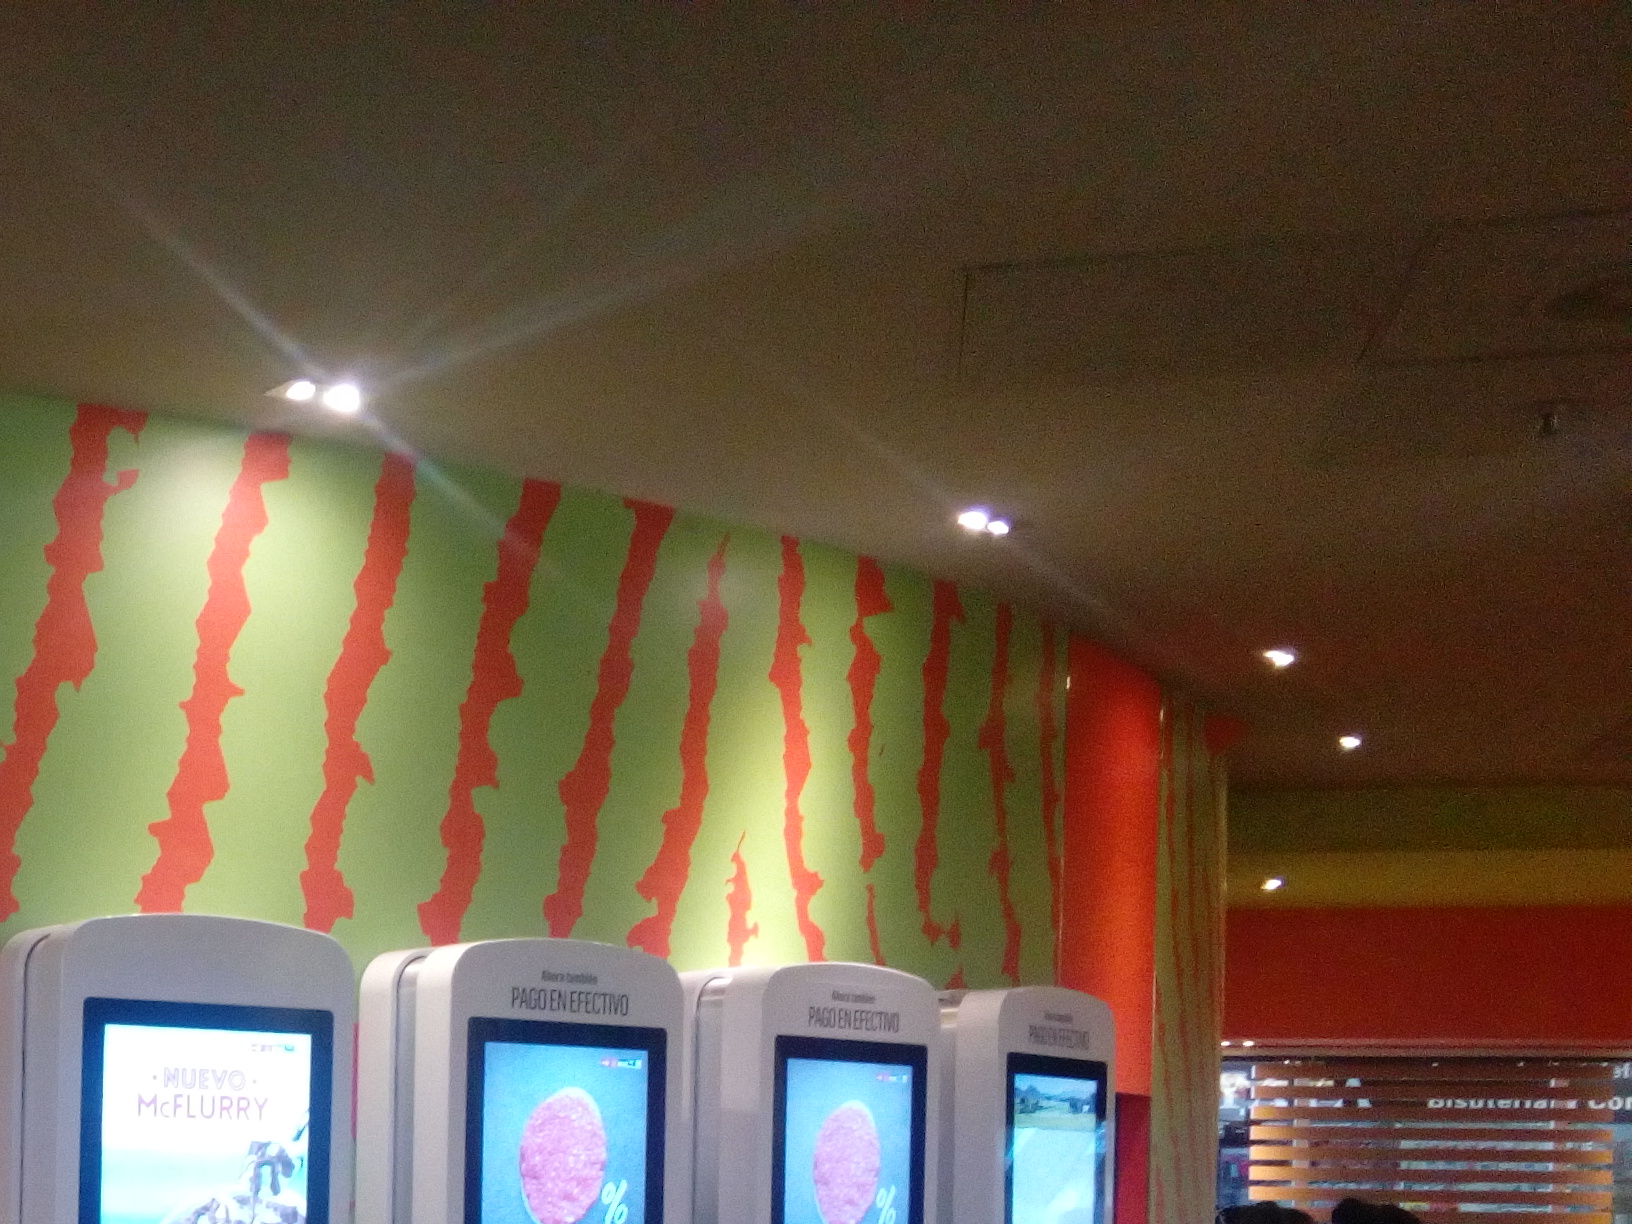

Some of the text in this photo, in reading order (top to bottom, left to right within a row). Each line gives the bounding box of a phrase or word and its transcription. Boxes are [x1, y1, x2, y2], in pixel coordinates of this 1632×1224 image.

[511, 987, 630, 1016] PAGO EN EFECTIVO
[808, 1006, 900, 1034] PAGO EN EFECTIVO
[163, 1067, 246, 1091] NUEVO
[137, 1093, 269, 1121] McFLURRY
